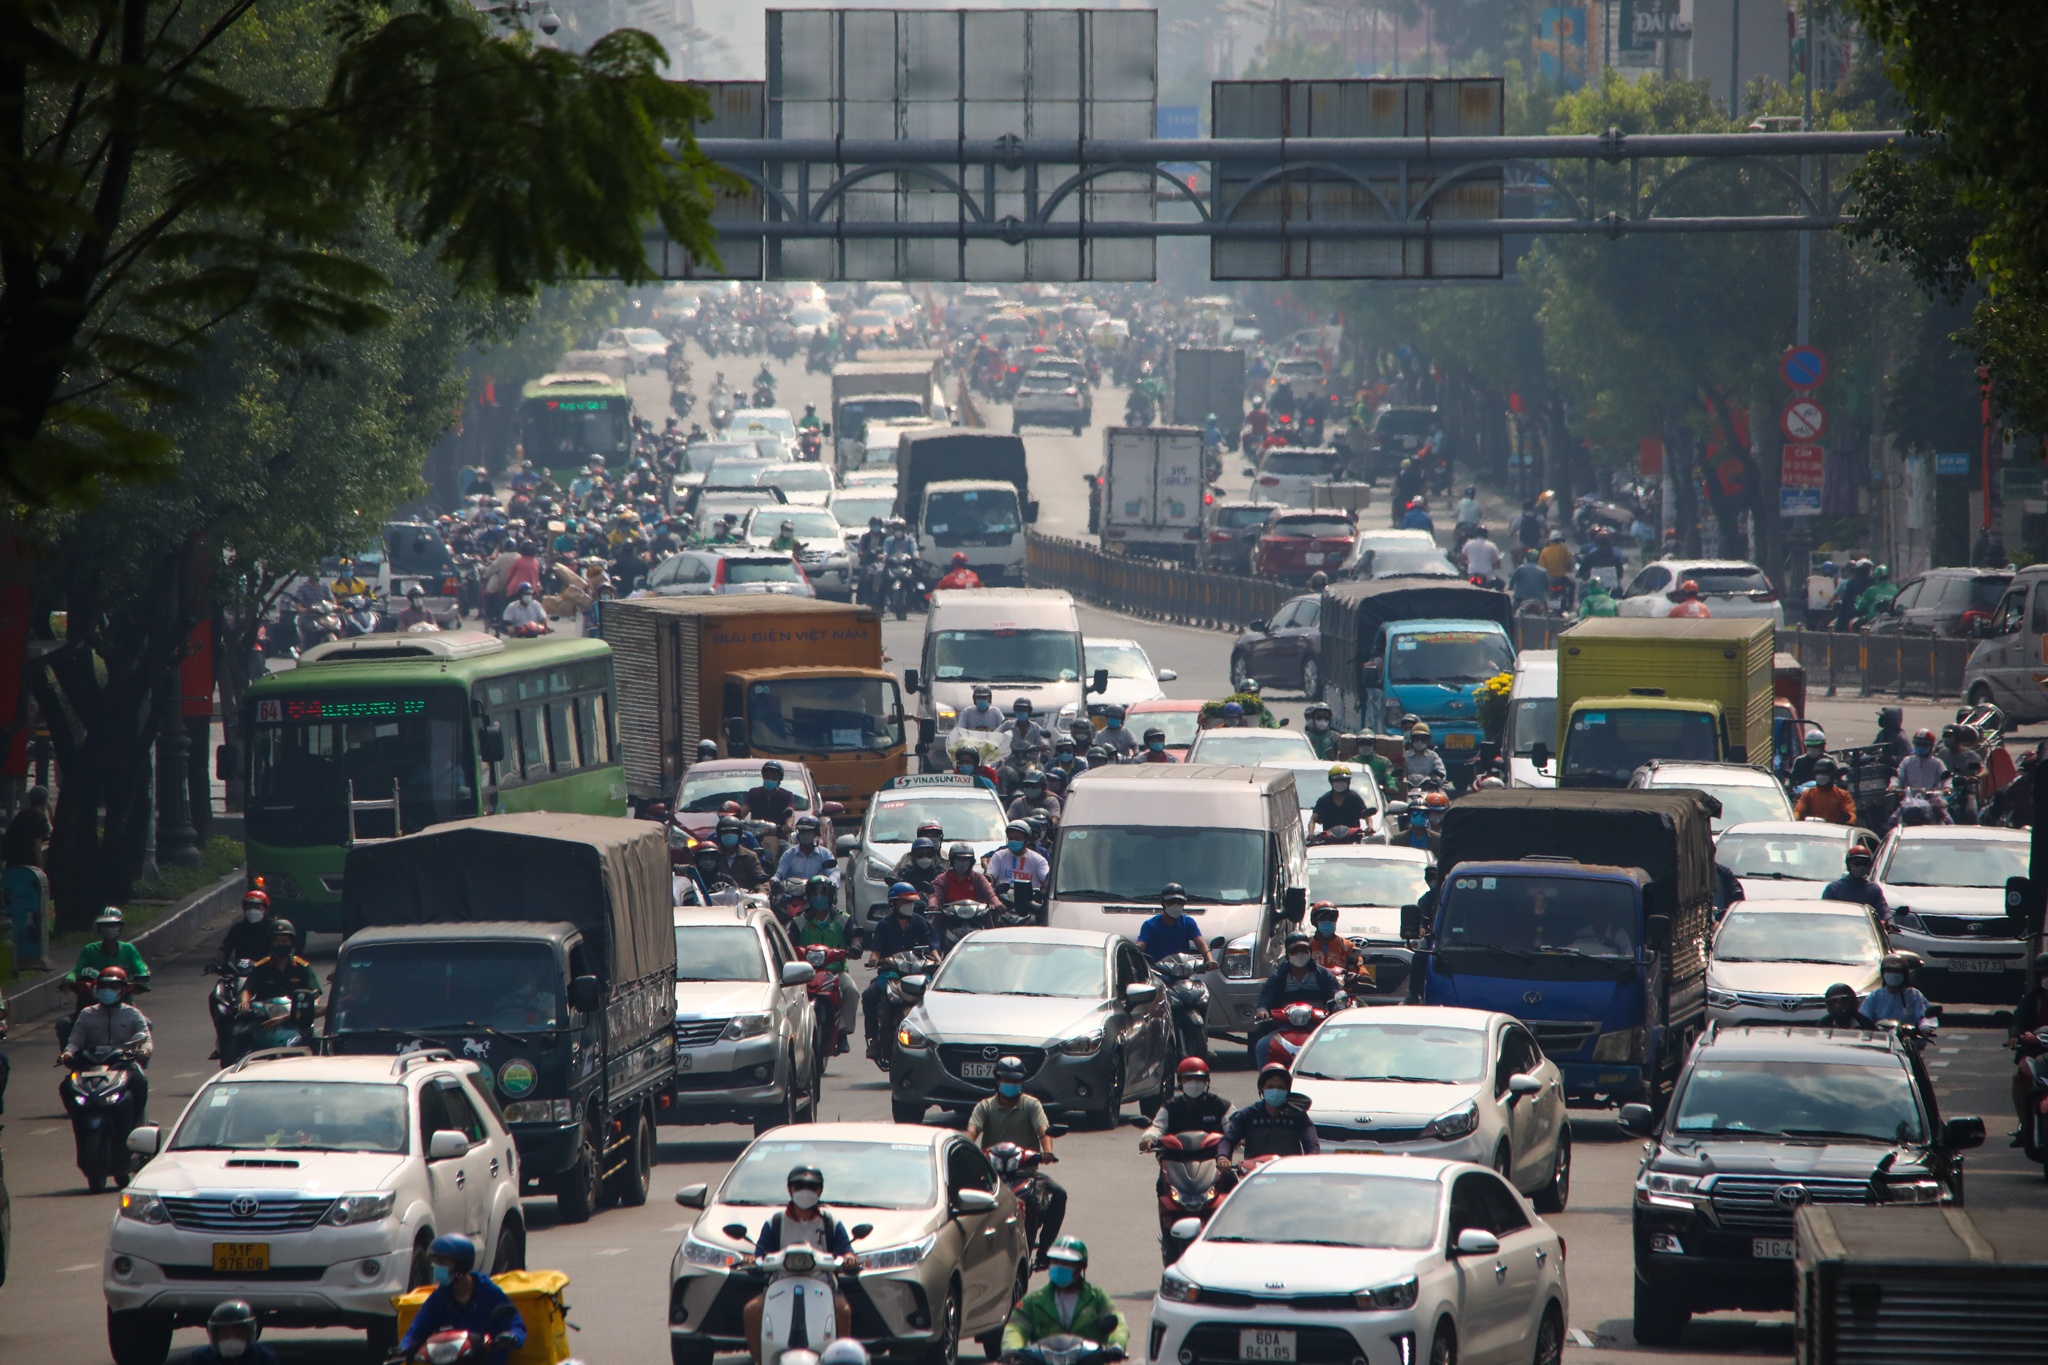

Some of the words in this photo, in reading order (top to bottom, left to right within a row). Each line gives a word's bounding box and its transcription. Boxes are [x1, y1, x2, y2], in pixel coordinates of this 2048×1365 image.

[795, 628, 828, 643] VIỆT
[832, 630, 869, 640] NAM
[260, 702, 278, 720] 64
[963, 1064, 995, 1077] 51G-7
[229, 1244, 253, 1256] 51F
[219, 1257, 263, 1270] 976.08
[1256, 1332, 1280, 1346] 60A
[1246, 1346, 1290, 1360] 841.85
